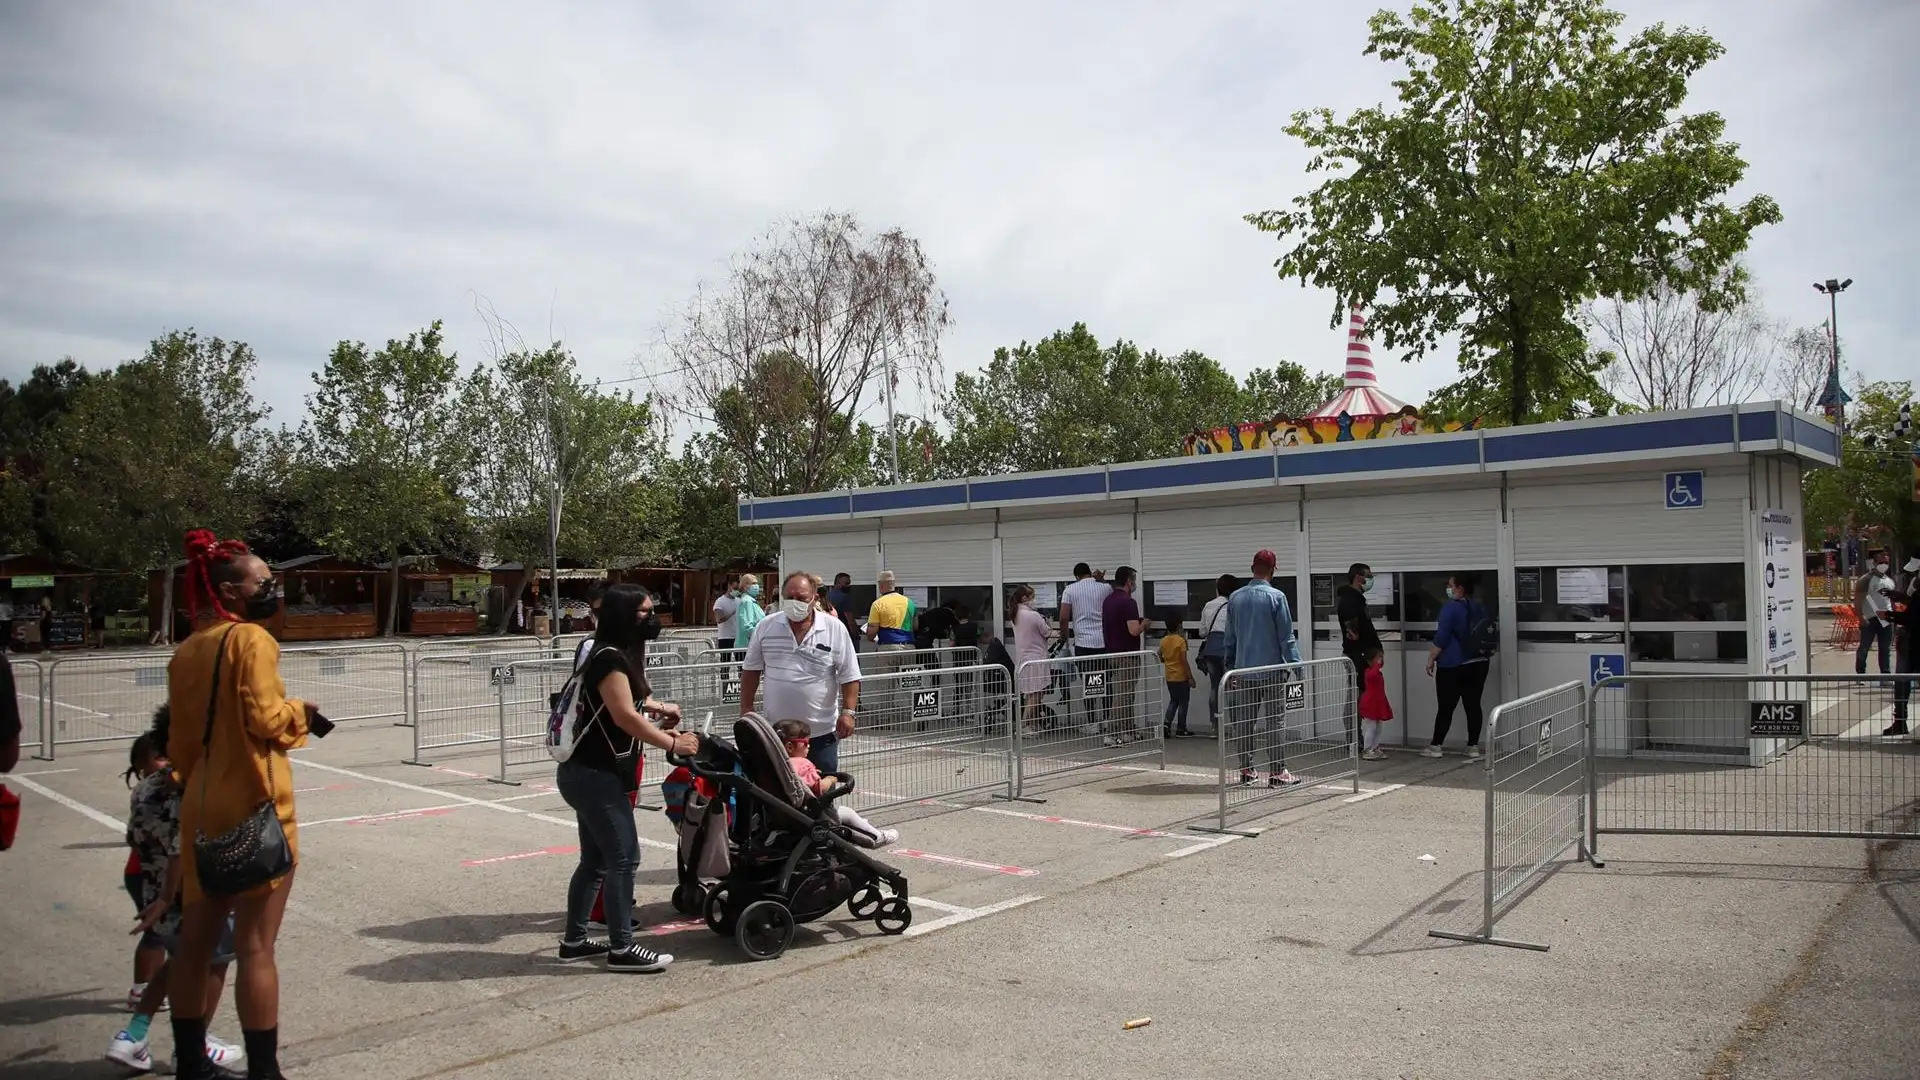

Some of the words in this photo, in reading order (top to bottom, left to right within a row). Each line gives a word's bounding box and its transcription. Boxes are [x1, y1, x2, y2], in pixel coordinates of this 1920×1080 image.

[1088, 674, 1102, 685] AMS
[1288, 684, 1302, 698] AMS
[917, 692, 935, 706] AMS
[1759, 705, 1795, 720] AMS
[1540, 721, 1551, 740] AMS
